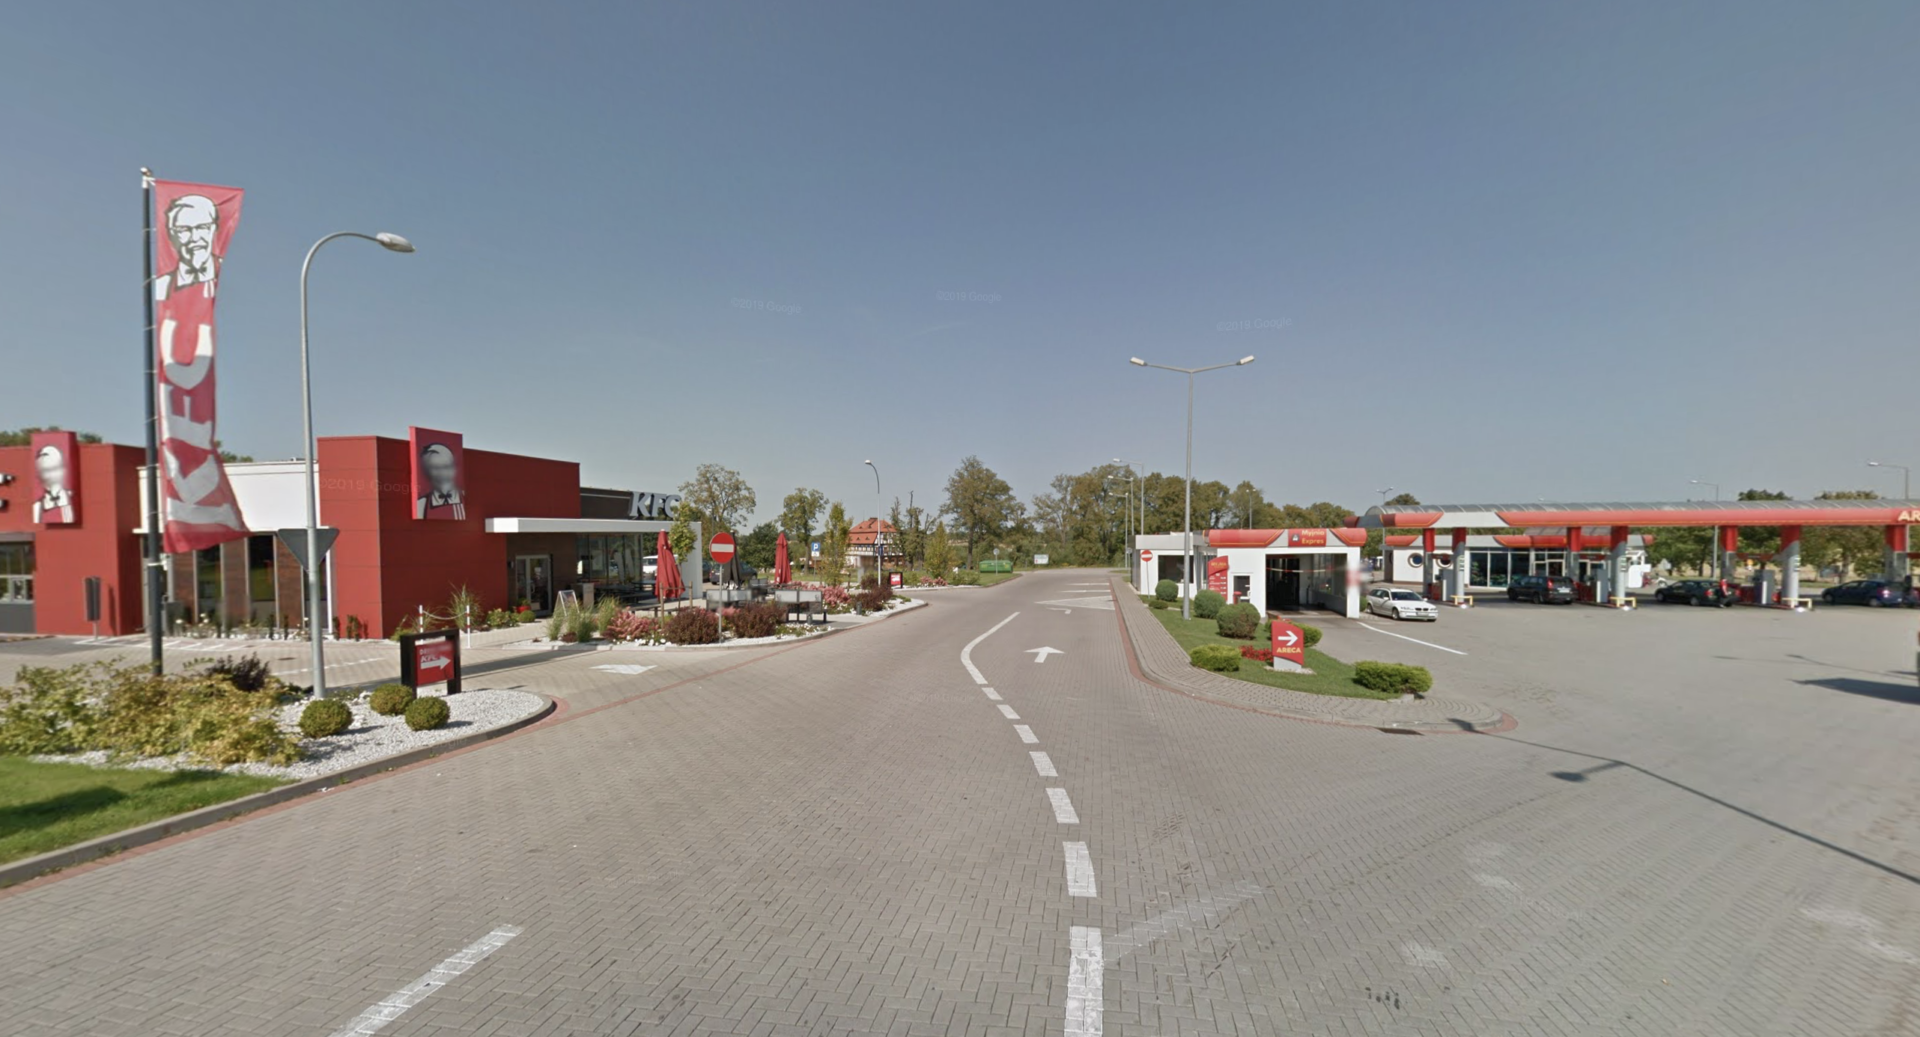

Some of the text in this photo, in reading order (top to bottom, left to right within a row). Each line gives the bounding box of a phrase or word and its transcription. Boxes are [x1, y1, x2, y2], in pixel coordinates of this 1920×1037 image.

[160, 318, 244, 531] KFC
[629, 491, 682, 519] KFC
[1897, 510, 1920, 522] AR
[813, 543, 819, 551] P
[1302, 538, 1324, 546] Expres
[1276, 646, 1302, 654] ARECA
